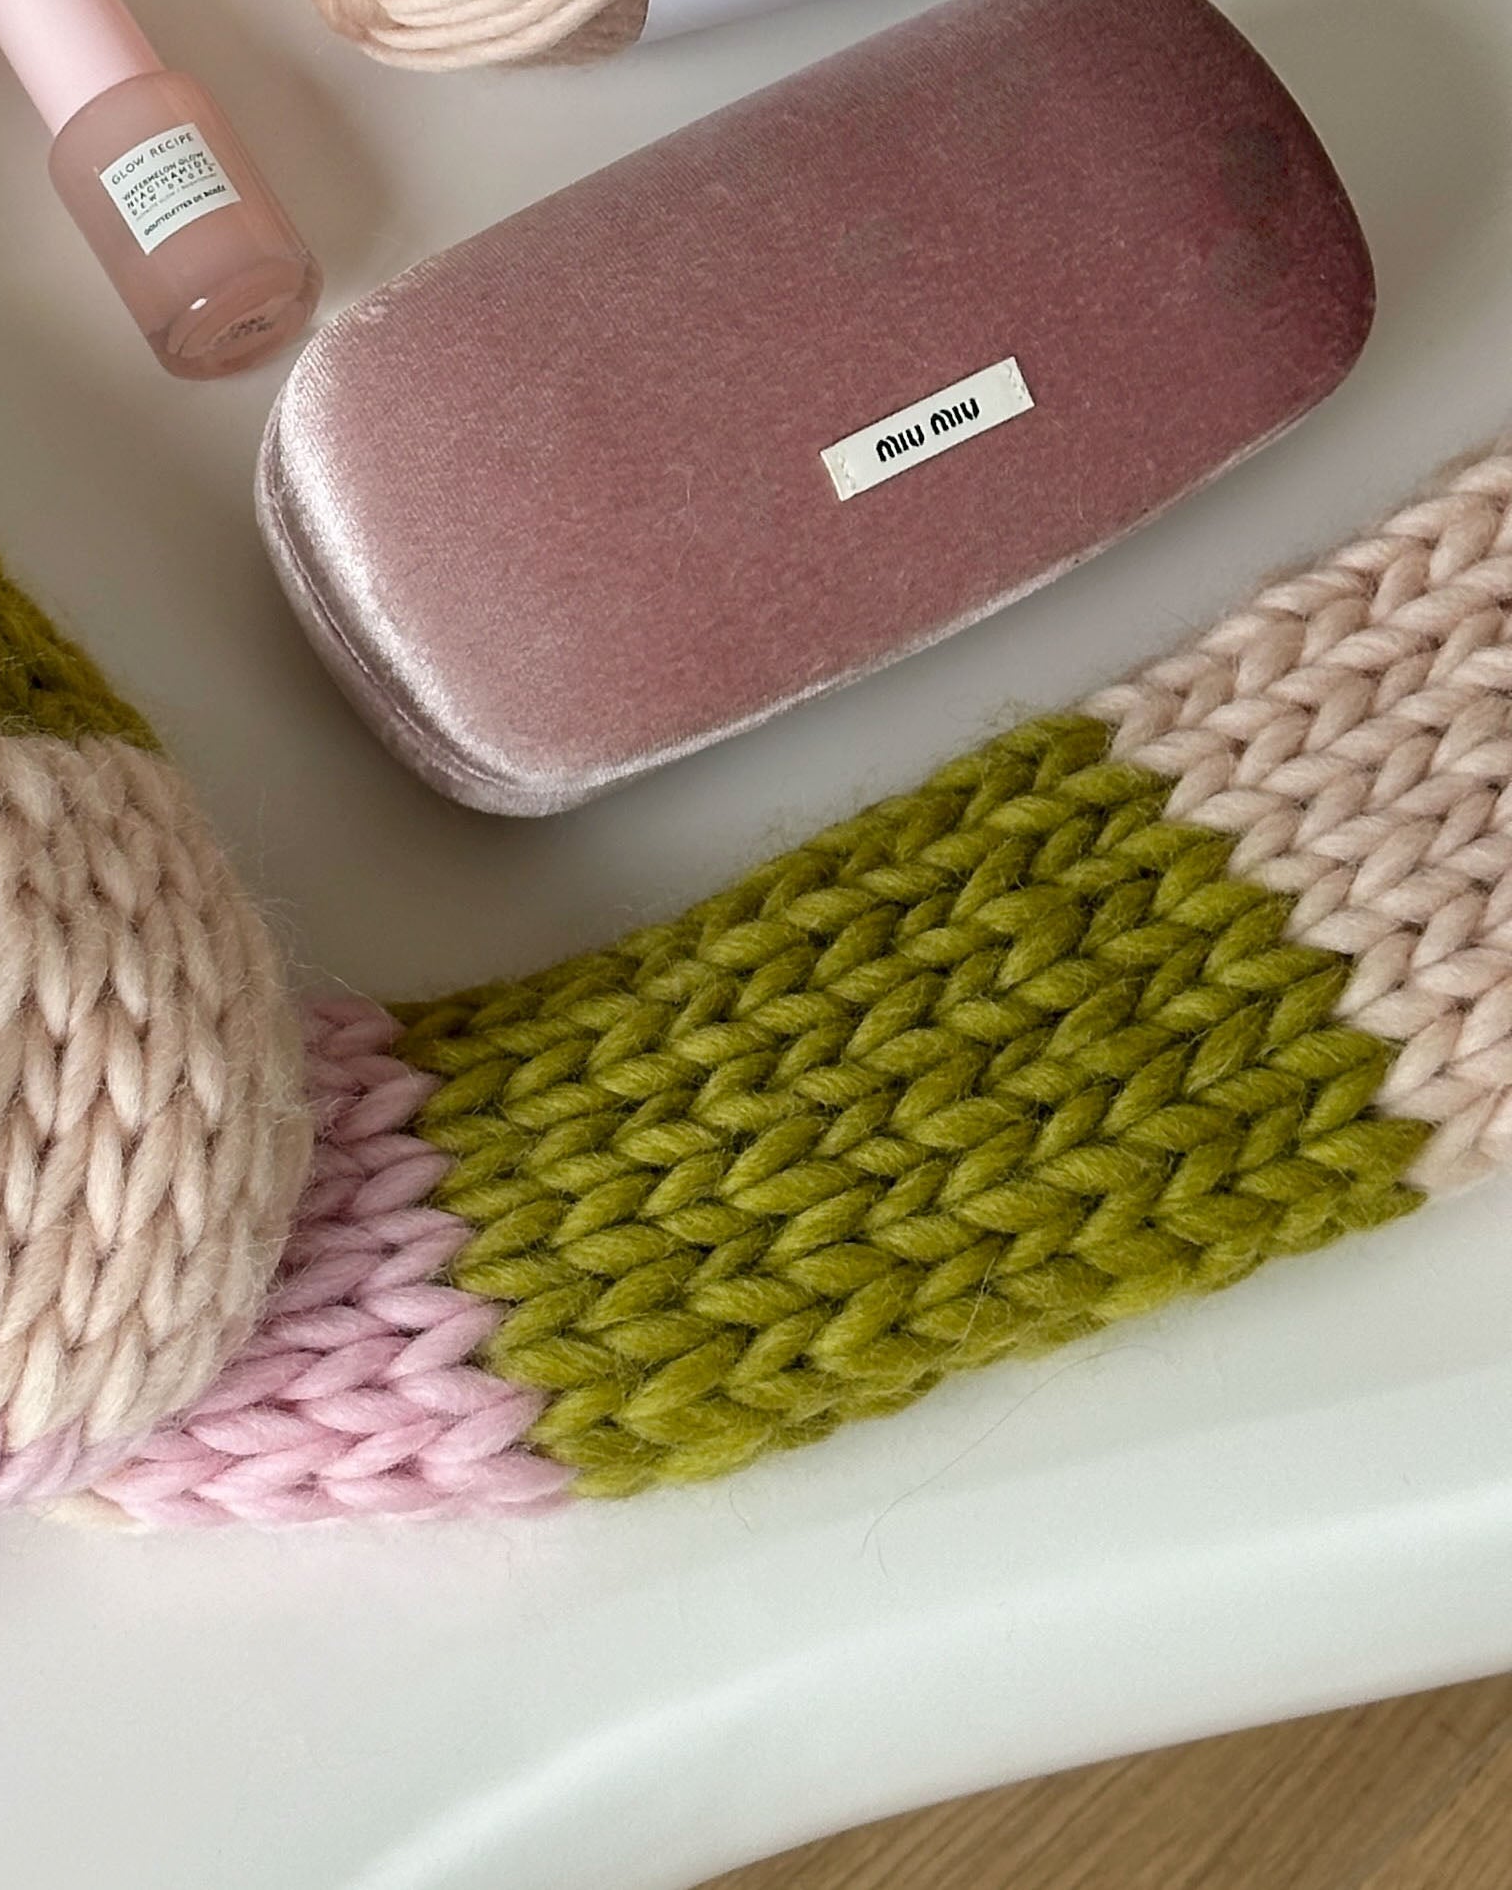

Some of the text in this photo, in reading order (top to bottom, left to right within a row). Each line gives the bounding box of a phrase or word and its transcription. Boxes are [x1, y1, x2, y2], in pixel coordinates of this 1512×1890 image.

[111, 132, 194, 185] GLOW RECIPE
[875, 398, 980, 462] MIU MIU
